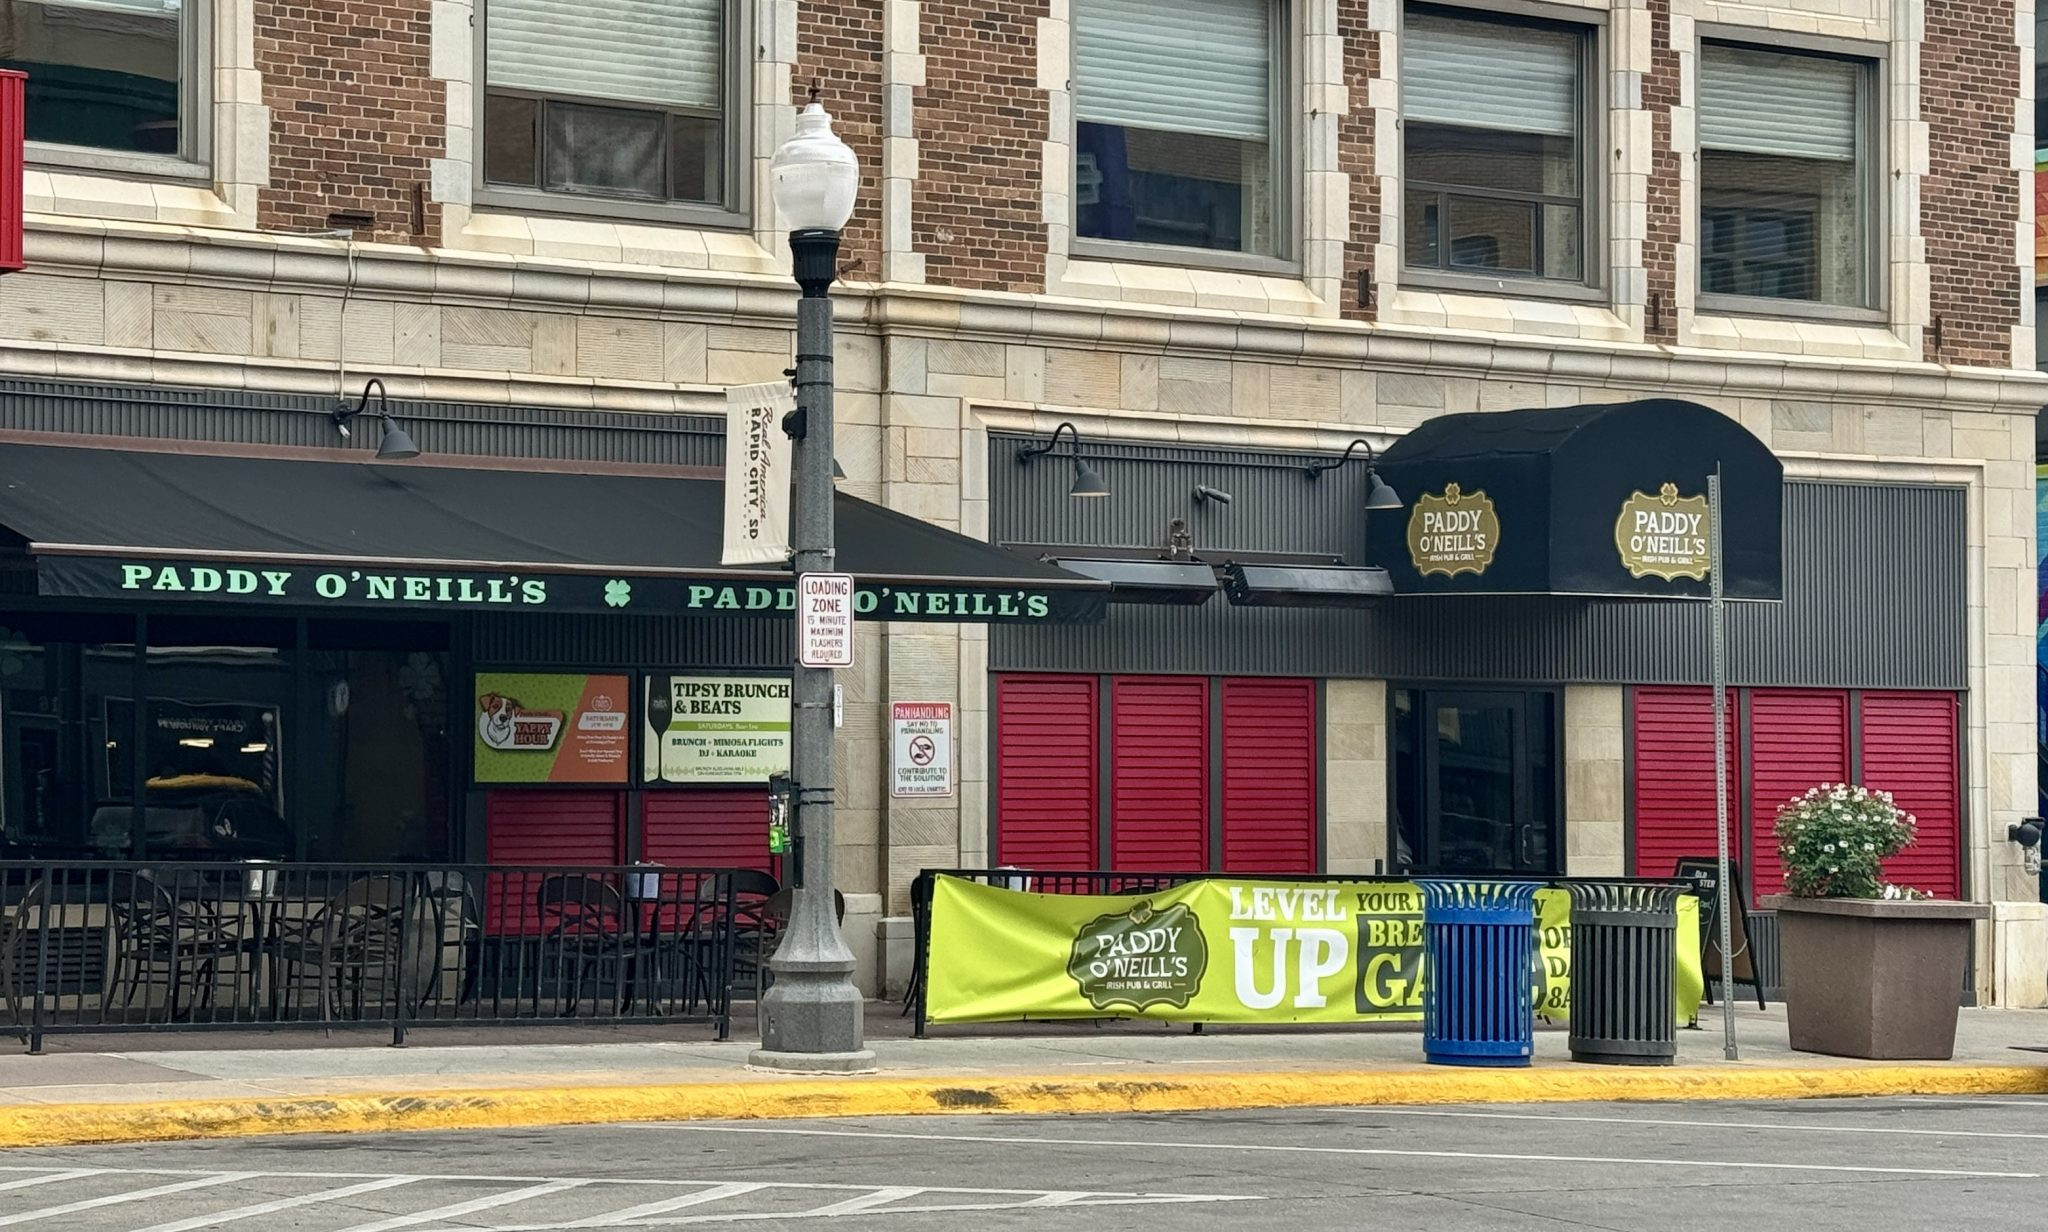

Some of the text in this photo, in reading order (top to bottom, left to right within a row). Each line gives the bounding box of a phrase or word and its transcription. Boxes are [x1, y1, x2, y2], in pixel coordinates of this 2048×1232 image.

[750, 408, 761, 461] RAPID
[759, 407, 774, 522] Real America
[749, 519, 759, 539] SD
[1424, 510, 1482, 533] PADDY
[1634, 510, 1702, 535] PADDY
[1420, 534, 1486, 552] O'NEILL'S
[1630, 535, 1706, 555] O'NEILL'S
[1642, 555, 1657, 563] IRISH
[1658, 556, 1670, 564] PUB
[121, 565, 546, 604] PADDY O'NEILL'S
[806, 581, 847, 595] LOADING
[688, 585, 1049, 617] PADD O'NEILL'S
[812, 599, 842, 612] ZONE
[807, 616, 847, 625] 15 MINUTE
[810, 627, 843, 636] MAXIMUM
[811, 639, 843, 647] FLASHERS
[812, 650, 842, 659] REQUIRED
[673, 683, 789, 698] TIPSY BRUNCH
[674, 700, 687, 714] &
[690, 700, 742, 714] BEATS
[895, 707, 949, 719] PANHANDLING
[515, 722, 552, 734] YAPPY
[514, 734, 549, 745] HOUR
[672, 738, 706, 746] BRUNCH
[1229, 887, 1347, 921] LEVEL
[1356, 893, 1414, 911] YOUR
[1094, 927, 1182, 958] PADDY
[1090, 957, 1188, 978] O'NEILL'S
[1229, 927, 1349, 1010] UP
[1106, 981, 1173, 990] IRISH PUB & GRILL
